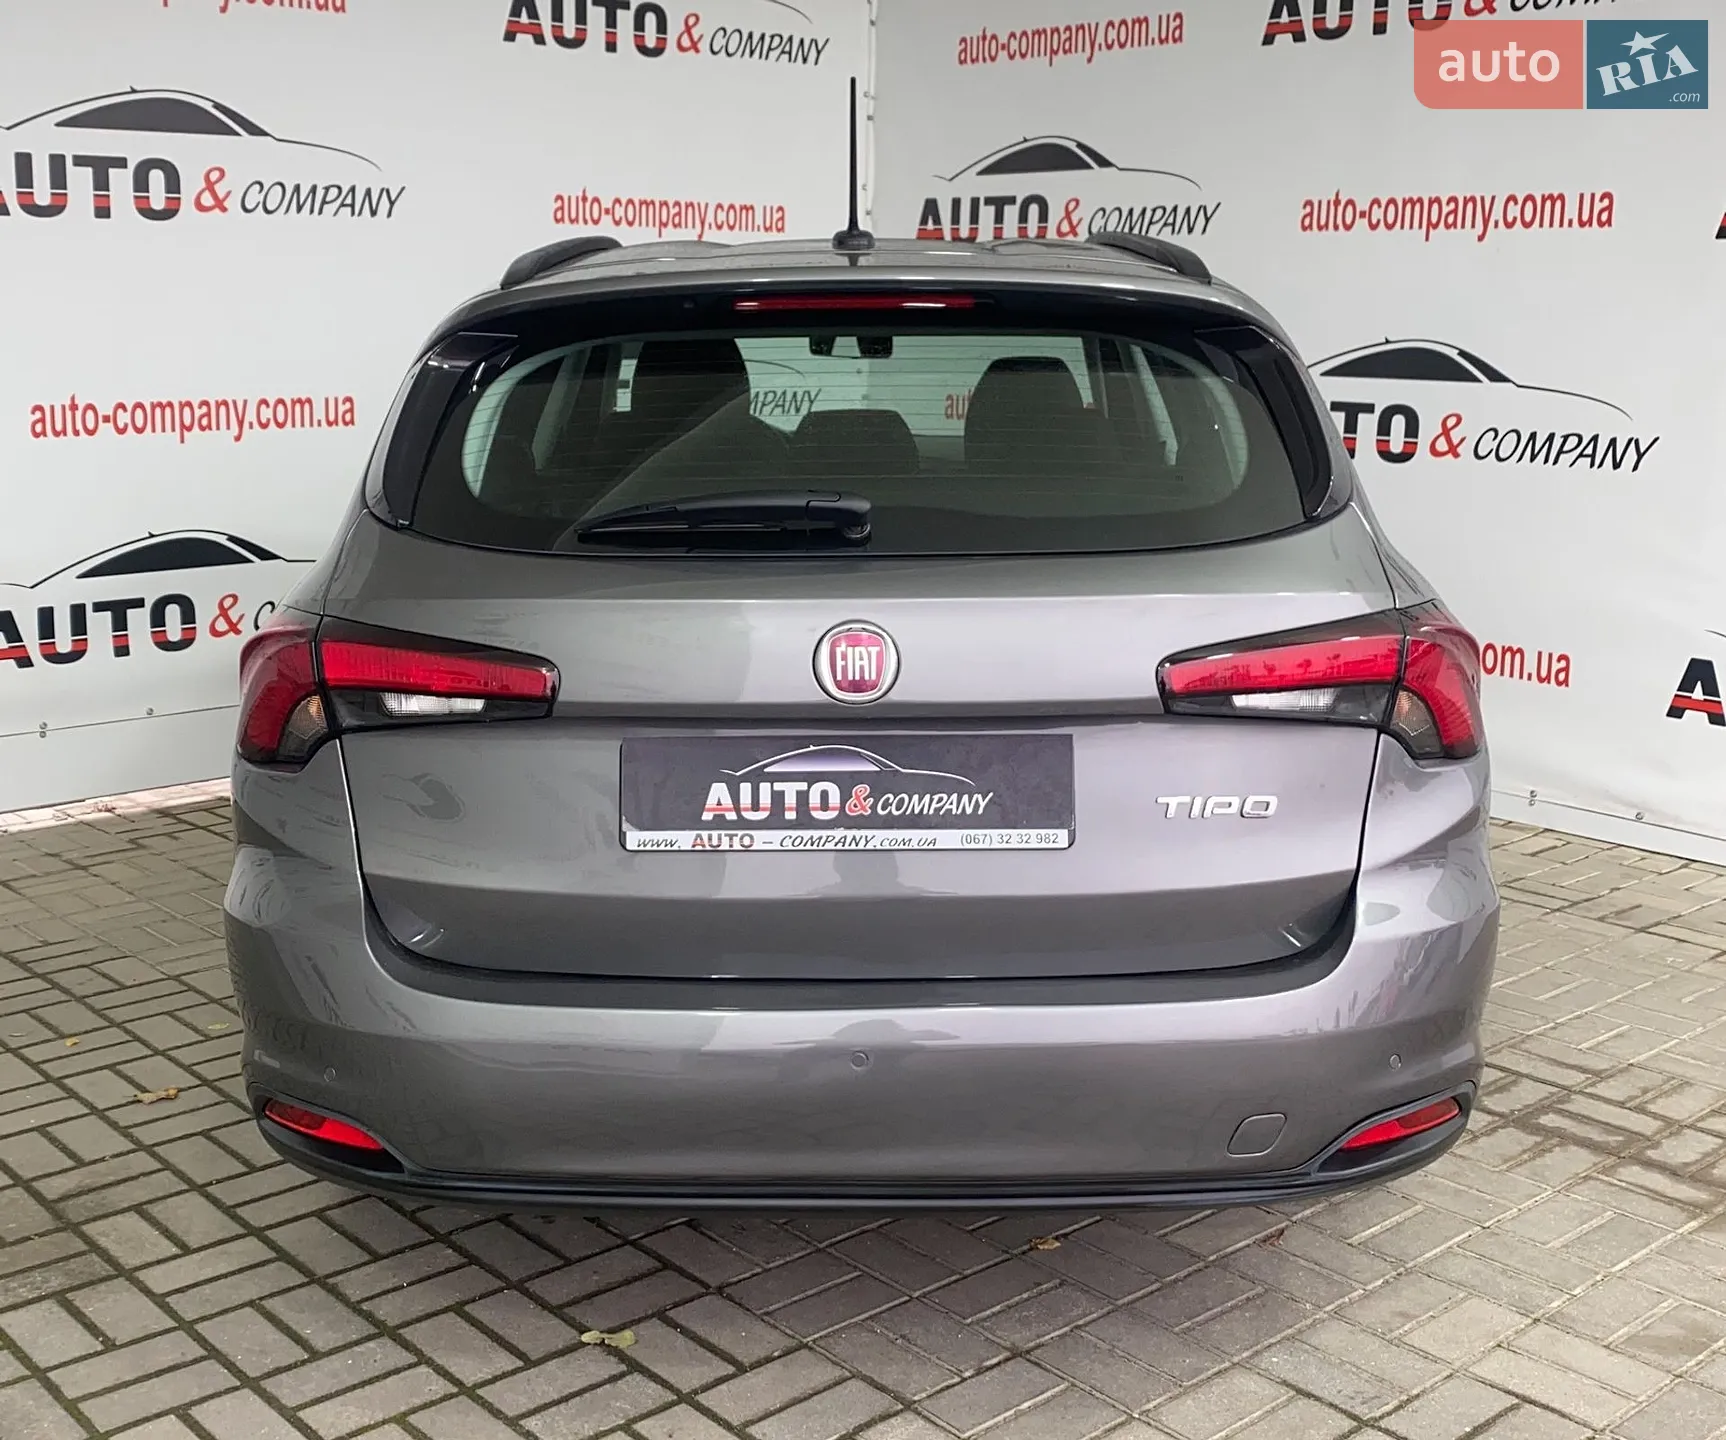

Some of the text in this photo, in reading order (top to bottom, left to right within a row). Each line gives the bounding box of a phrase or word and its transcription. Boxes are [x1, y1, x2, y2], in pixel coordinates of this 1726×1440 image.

[502, 0, 829, 66] AUTO & COMPANY
[957, 11, 1184, 67] auto-company.com.ua
[0, 151, 406, 222] UTO & COMPANY
[553, 187, 786, 239] auto-company.com.ua
[916, 194, 1222, 243] AUTO & COMPANY
[1300, 189, 1615, 243] auto-company.com.ua
[30, 393, 357, 444] auto-company.com.ua
[1428, 412, 1467, 460] &
[1473, 427, 1660, 473] COMPANY
[208, 593, 245, 639] &
[835, 645, 881, 681] FIAT
[701, 781, 994, 821] AUTO & COMPANY
[1156, 795, 1279, 819] TIPO
[691, 833, 755, 849] AUTO
[960, 833, 993, 846] (067)
[997, 833, 1012, 845] 32
[1016, 833, 1032, 845] 32
[1035, 832, 1059, 845] 982
